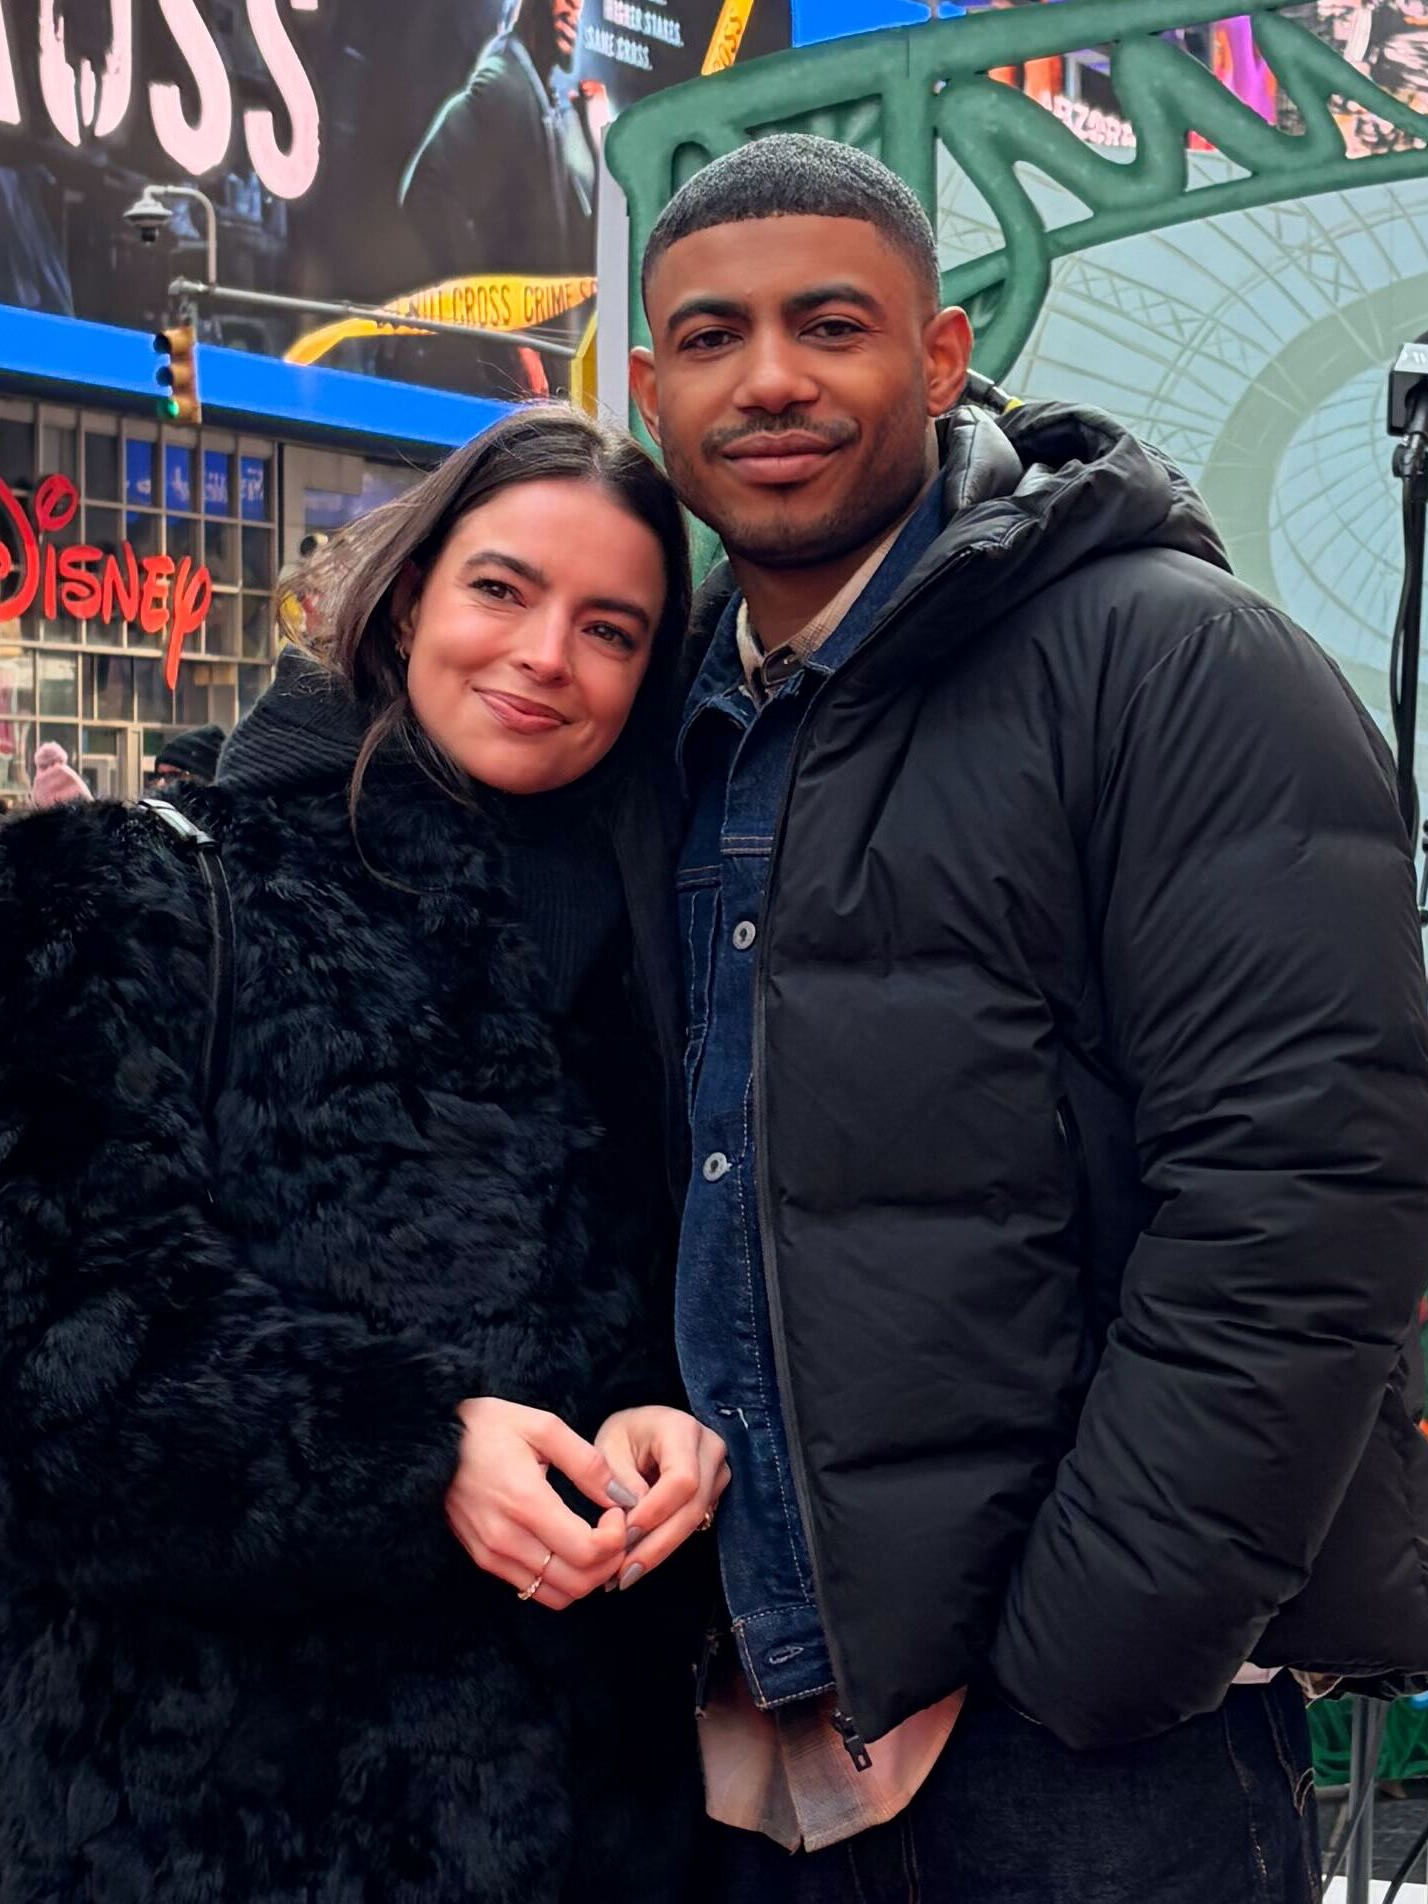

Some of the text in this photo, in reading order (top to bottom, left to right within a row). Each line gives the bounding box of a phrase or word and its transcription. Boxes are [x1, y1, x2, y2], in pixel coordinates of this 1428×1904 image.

[583, 24, 616, 58] SAME
[452, 283, 512, 327] CROSS
[523, 282, 573, 324] CRIME
